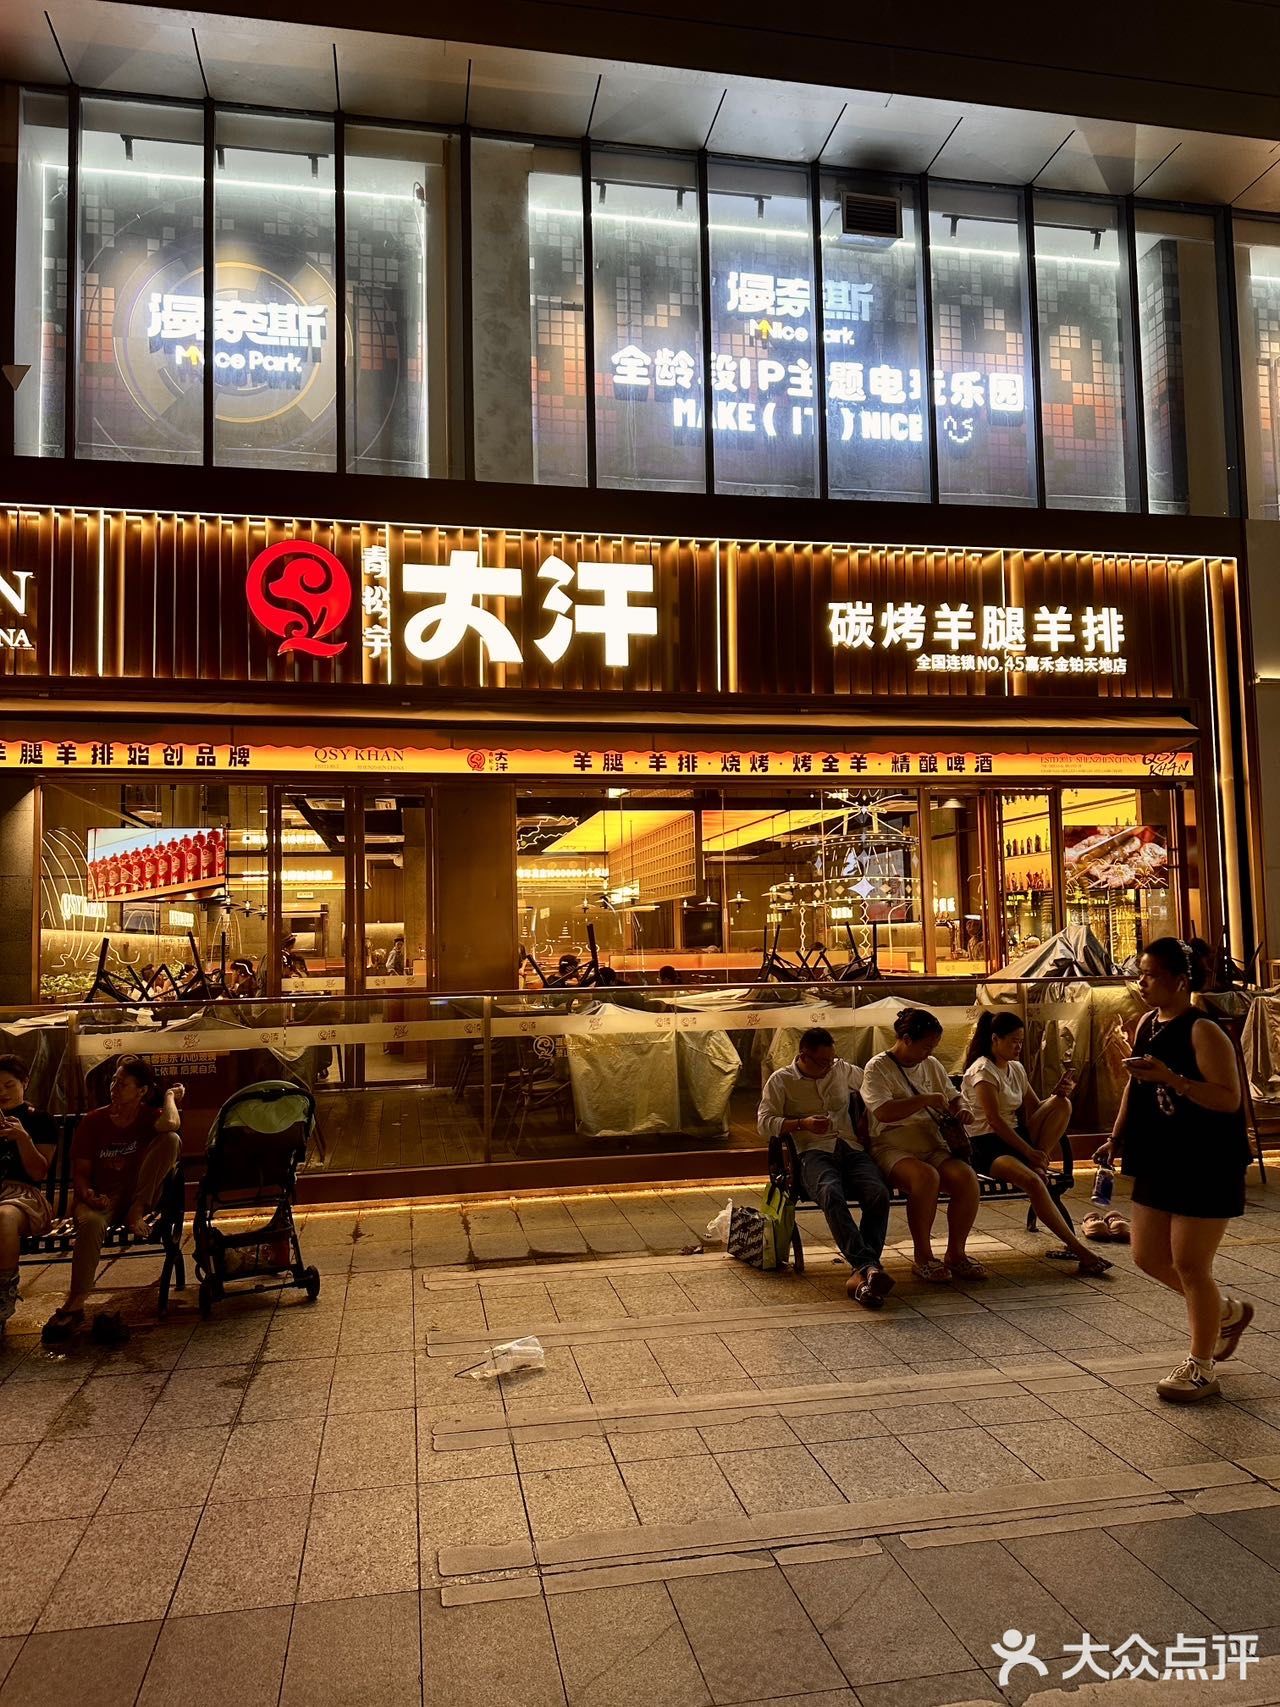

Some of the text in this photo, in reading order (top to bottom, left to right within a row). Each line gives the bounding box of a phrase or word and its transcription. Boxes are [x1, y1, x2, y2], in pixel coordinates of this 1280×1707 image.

[402, 549, 658, 667] 大汗
[827, 600, 1126, 653] 碳烤羊腿羊排
[314, 749, 404, 763] QSY KHAN
